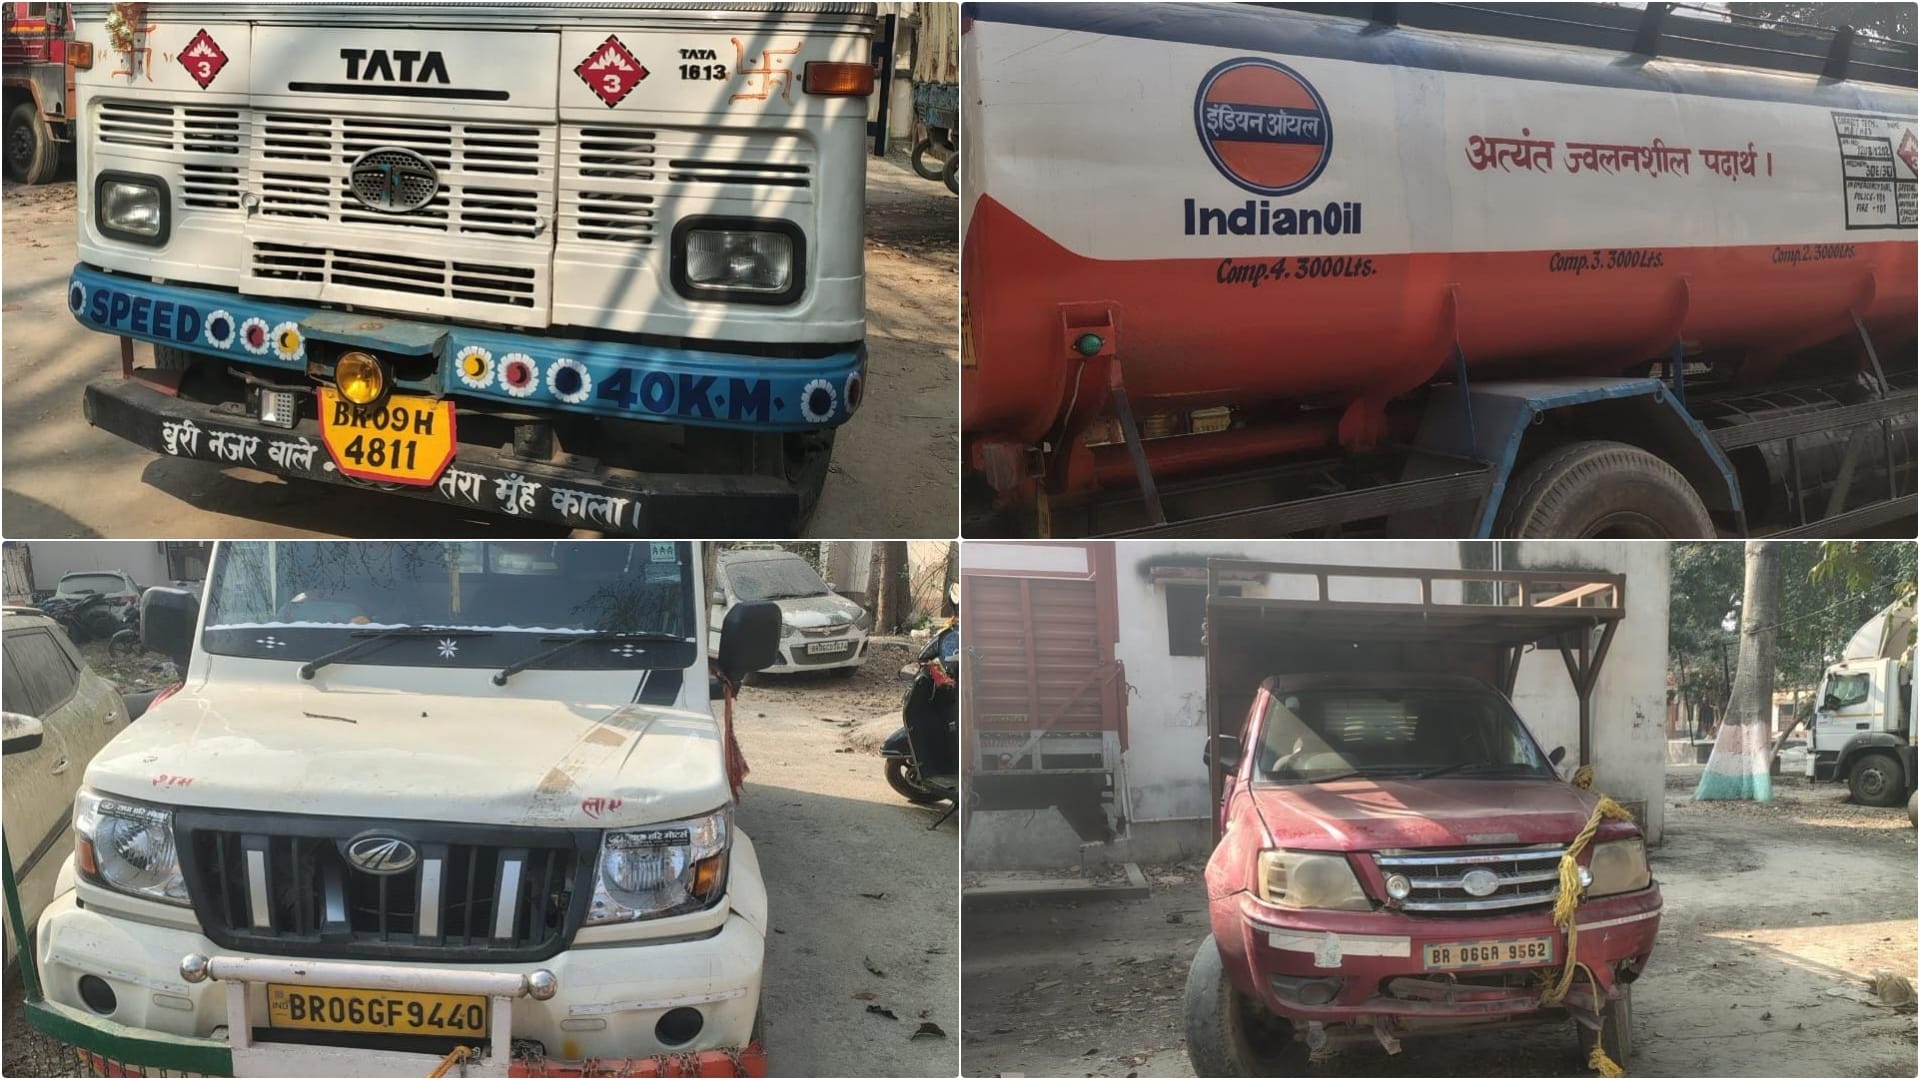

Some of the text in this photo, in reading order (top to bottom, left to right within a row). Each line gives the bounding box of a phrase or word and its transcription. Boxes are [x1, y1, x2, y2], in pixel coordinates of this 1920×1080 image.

[197, 61, 210, 78] 3
[340, 48, 450, 84] TATA
[679, 48, 717, 61] TATA
[679, 64, 727, 81] 1613
[603, 74, 622, 94] 3
[1206, 104, 1320, 137] इंडियन ऑयल
[1465, 127, 1556, 173] अत्यंत
[1564, 138, 1691, 178] ज्वलनशील
[1184, 198, 1362, 235] IndianOil
[90, 288, 201, 342] SPEED
[162, 420, 203, 457] बुरी
[208, 430, 262, 466] नजर
[268, 437, 318, 472] वाले
[344, 434, 417, 471] 4811
[1433, 949, 1450, 963] BR
[1509, 943, 1546, 959] 9562
[289, 993, 484, 1030] BR06GF9440
